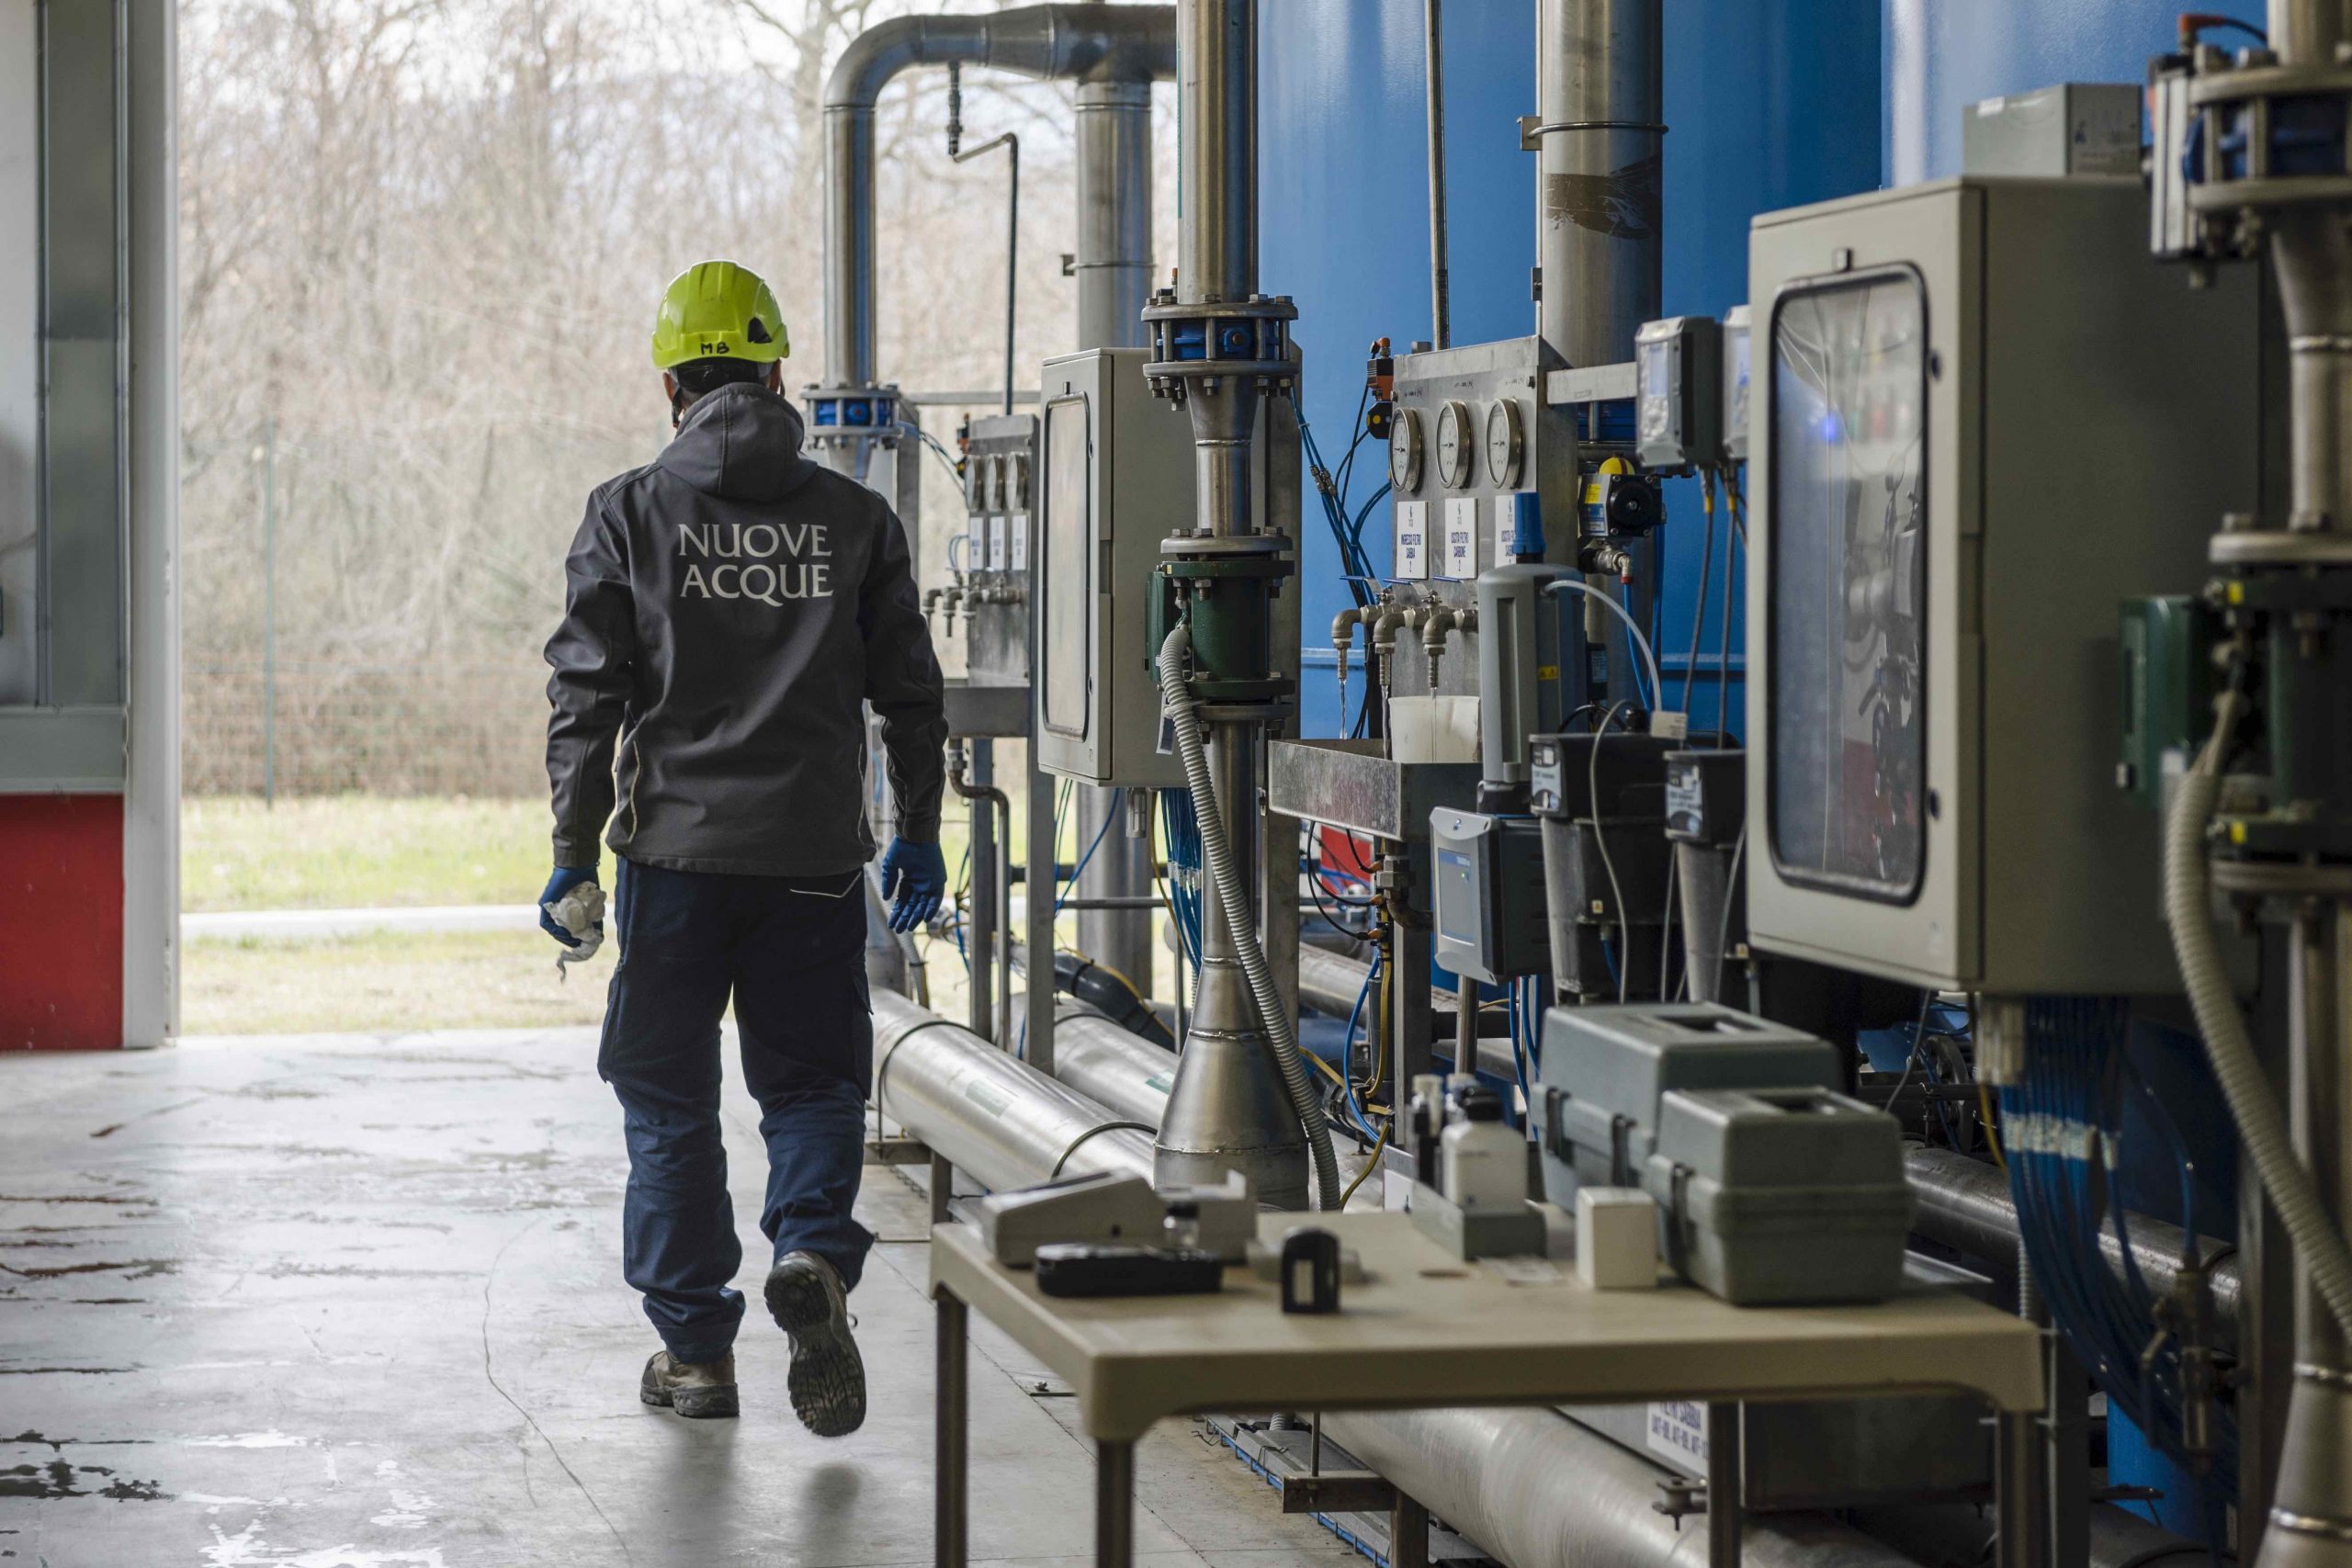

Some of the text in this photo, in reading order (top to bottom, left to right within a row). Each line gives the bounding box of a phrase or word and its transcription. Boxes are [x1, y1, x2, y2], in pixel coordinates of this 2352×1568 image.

[700, 342, 729, 355] MB
[678, 523, 832, 558] NUOVE
[680, 564, 834, 607] ACQUE
